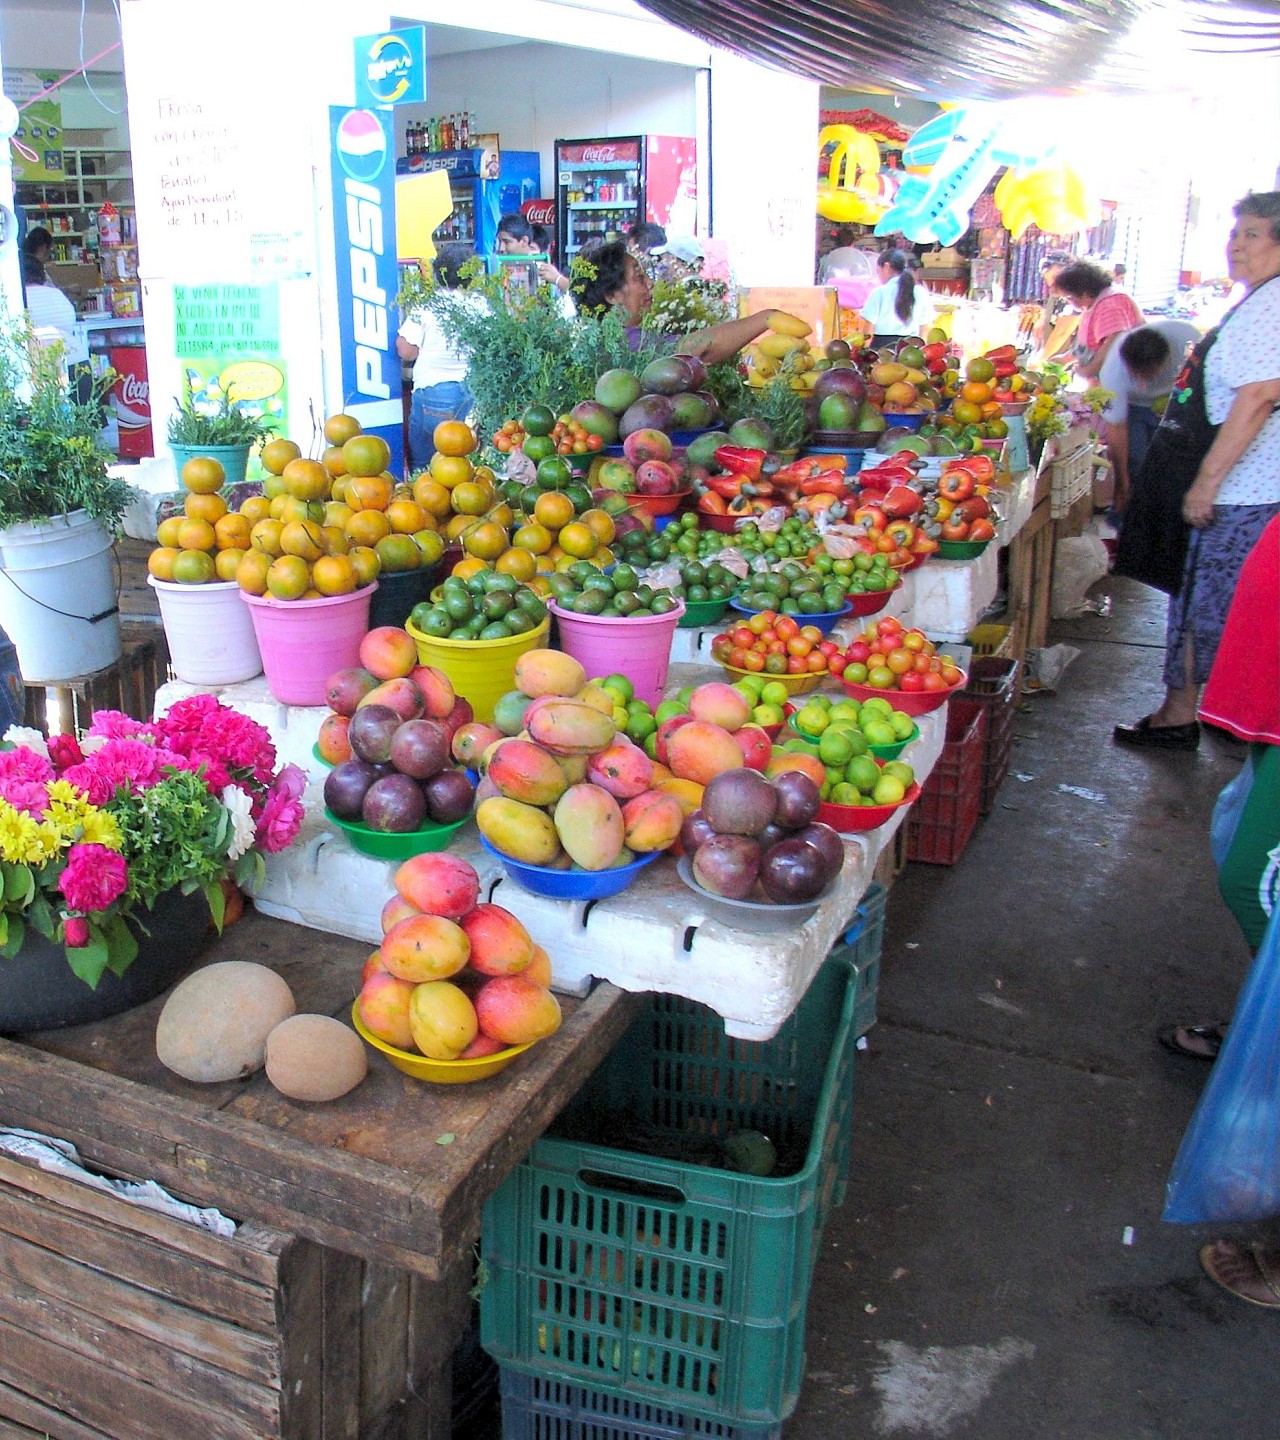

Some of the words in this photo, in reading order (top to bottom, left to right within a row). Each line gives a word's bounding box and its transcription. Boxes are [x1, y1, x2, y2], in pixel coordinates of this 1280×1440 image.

[582, 147, 616, 163] Coca-Cola
[422, 157, 458, 171] PEPSI
[344, 177, 390, 400] PEPSI
